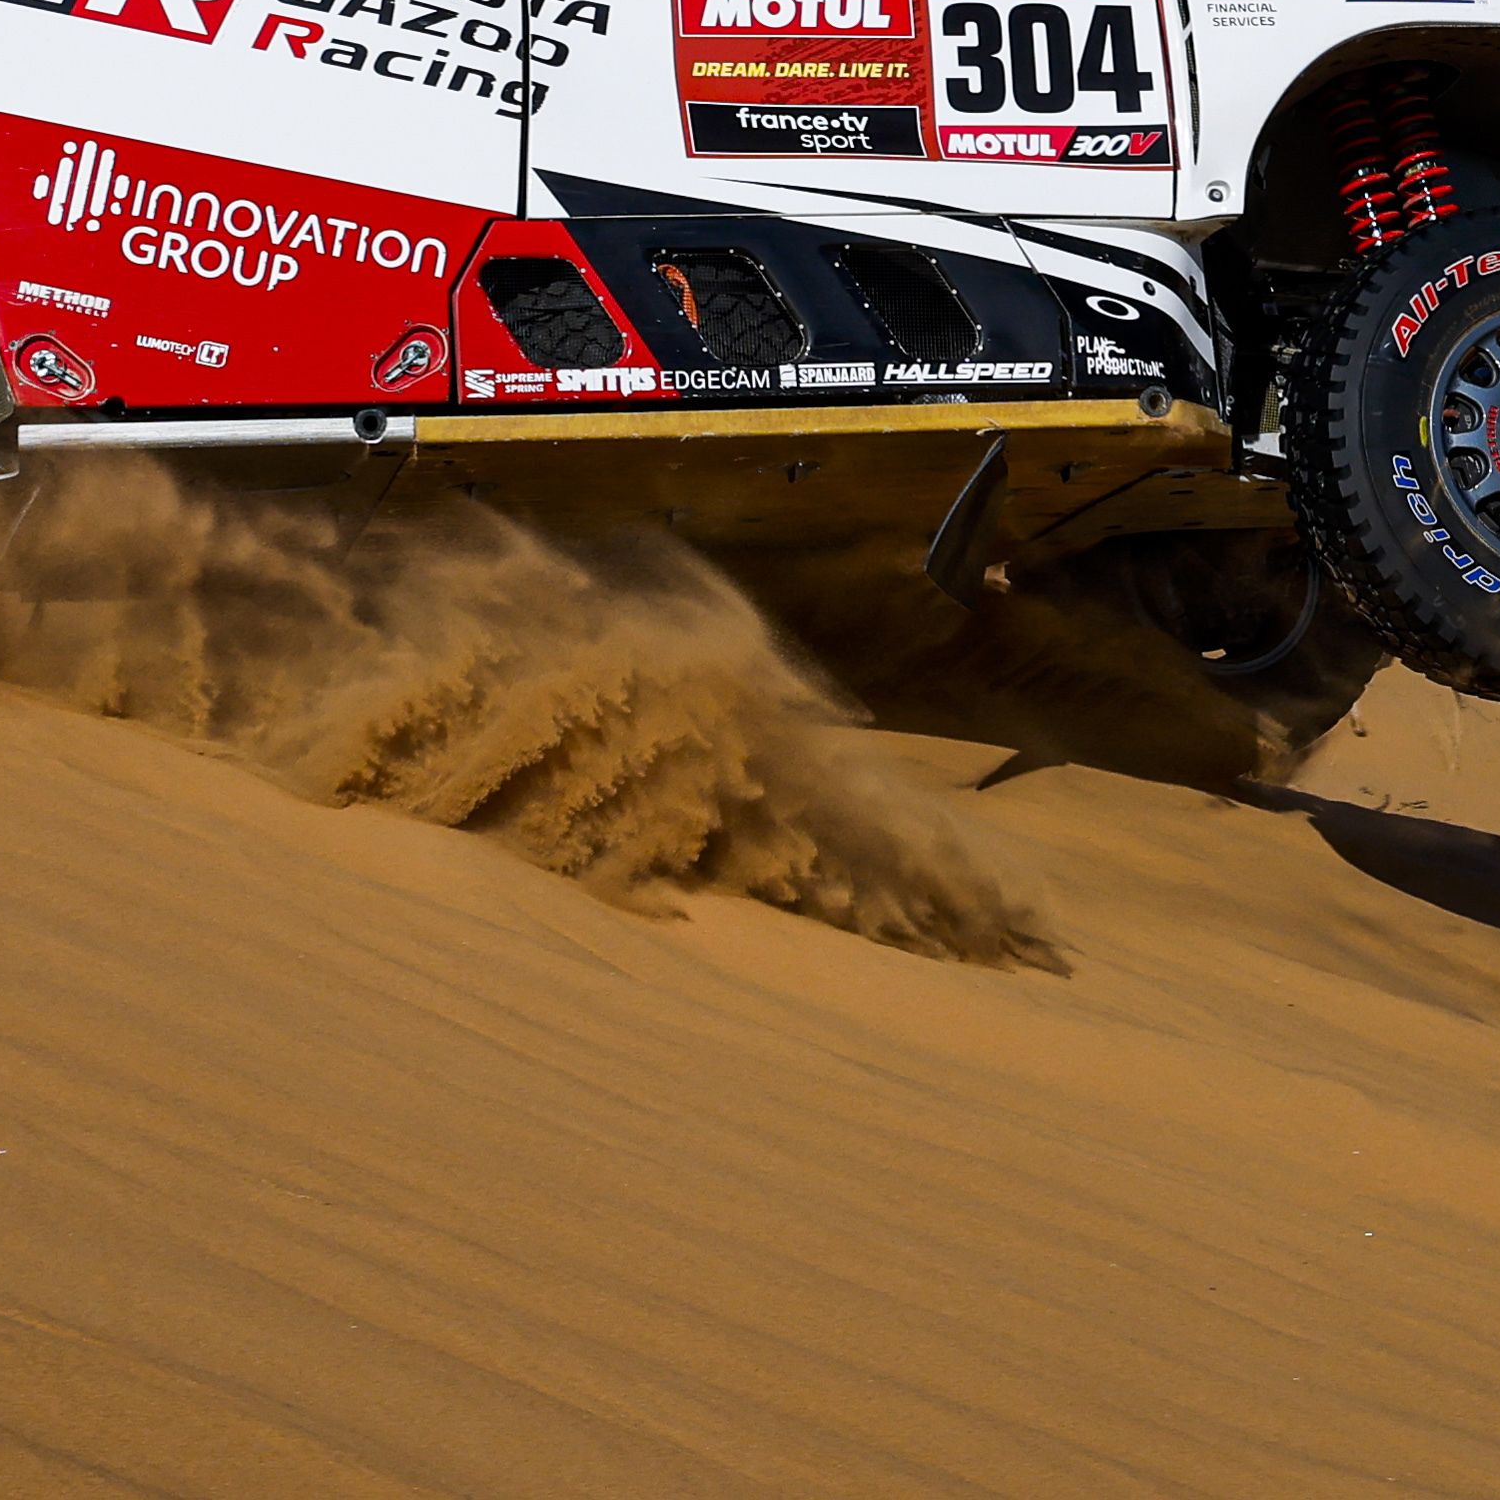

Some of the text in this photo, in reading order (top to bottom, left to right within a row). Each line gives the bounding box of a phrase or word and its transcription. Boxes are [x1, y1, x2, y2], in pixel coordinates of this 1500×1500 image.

[1207, 3, 1278, 13] FINANCIAL
[1213, 16, 1276, 27] SERVICES
[251, 14, 550, 120] Racing
[942, 2, 1154, 114] 304
[692, 62, 911, 79] DREAM. DARE. LIVE IT.
[801, 132, 873, 153] sport
[947, 132, 1162, 156] MOTUL 300V
[130, 179, 448, 279] INNOVATION
[121, 225, 300, 292] GROUP
[18, 280, 112, 313] METHOD
[495, 372, 553, 383] SUPREME
[556, 367, 656, 397] SMITHS
[660, 369, 771, 390] EDGECAM
[799, 366, 876, 384] SPANJAARD
[884, 362, 1053, 381] HALLSPEED
[504, 384, 545, 394] SPRING
